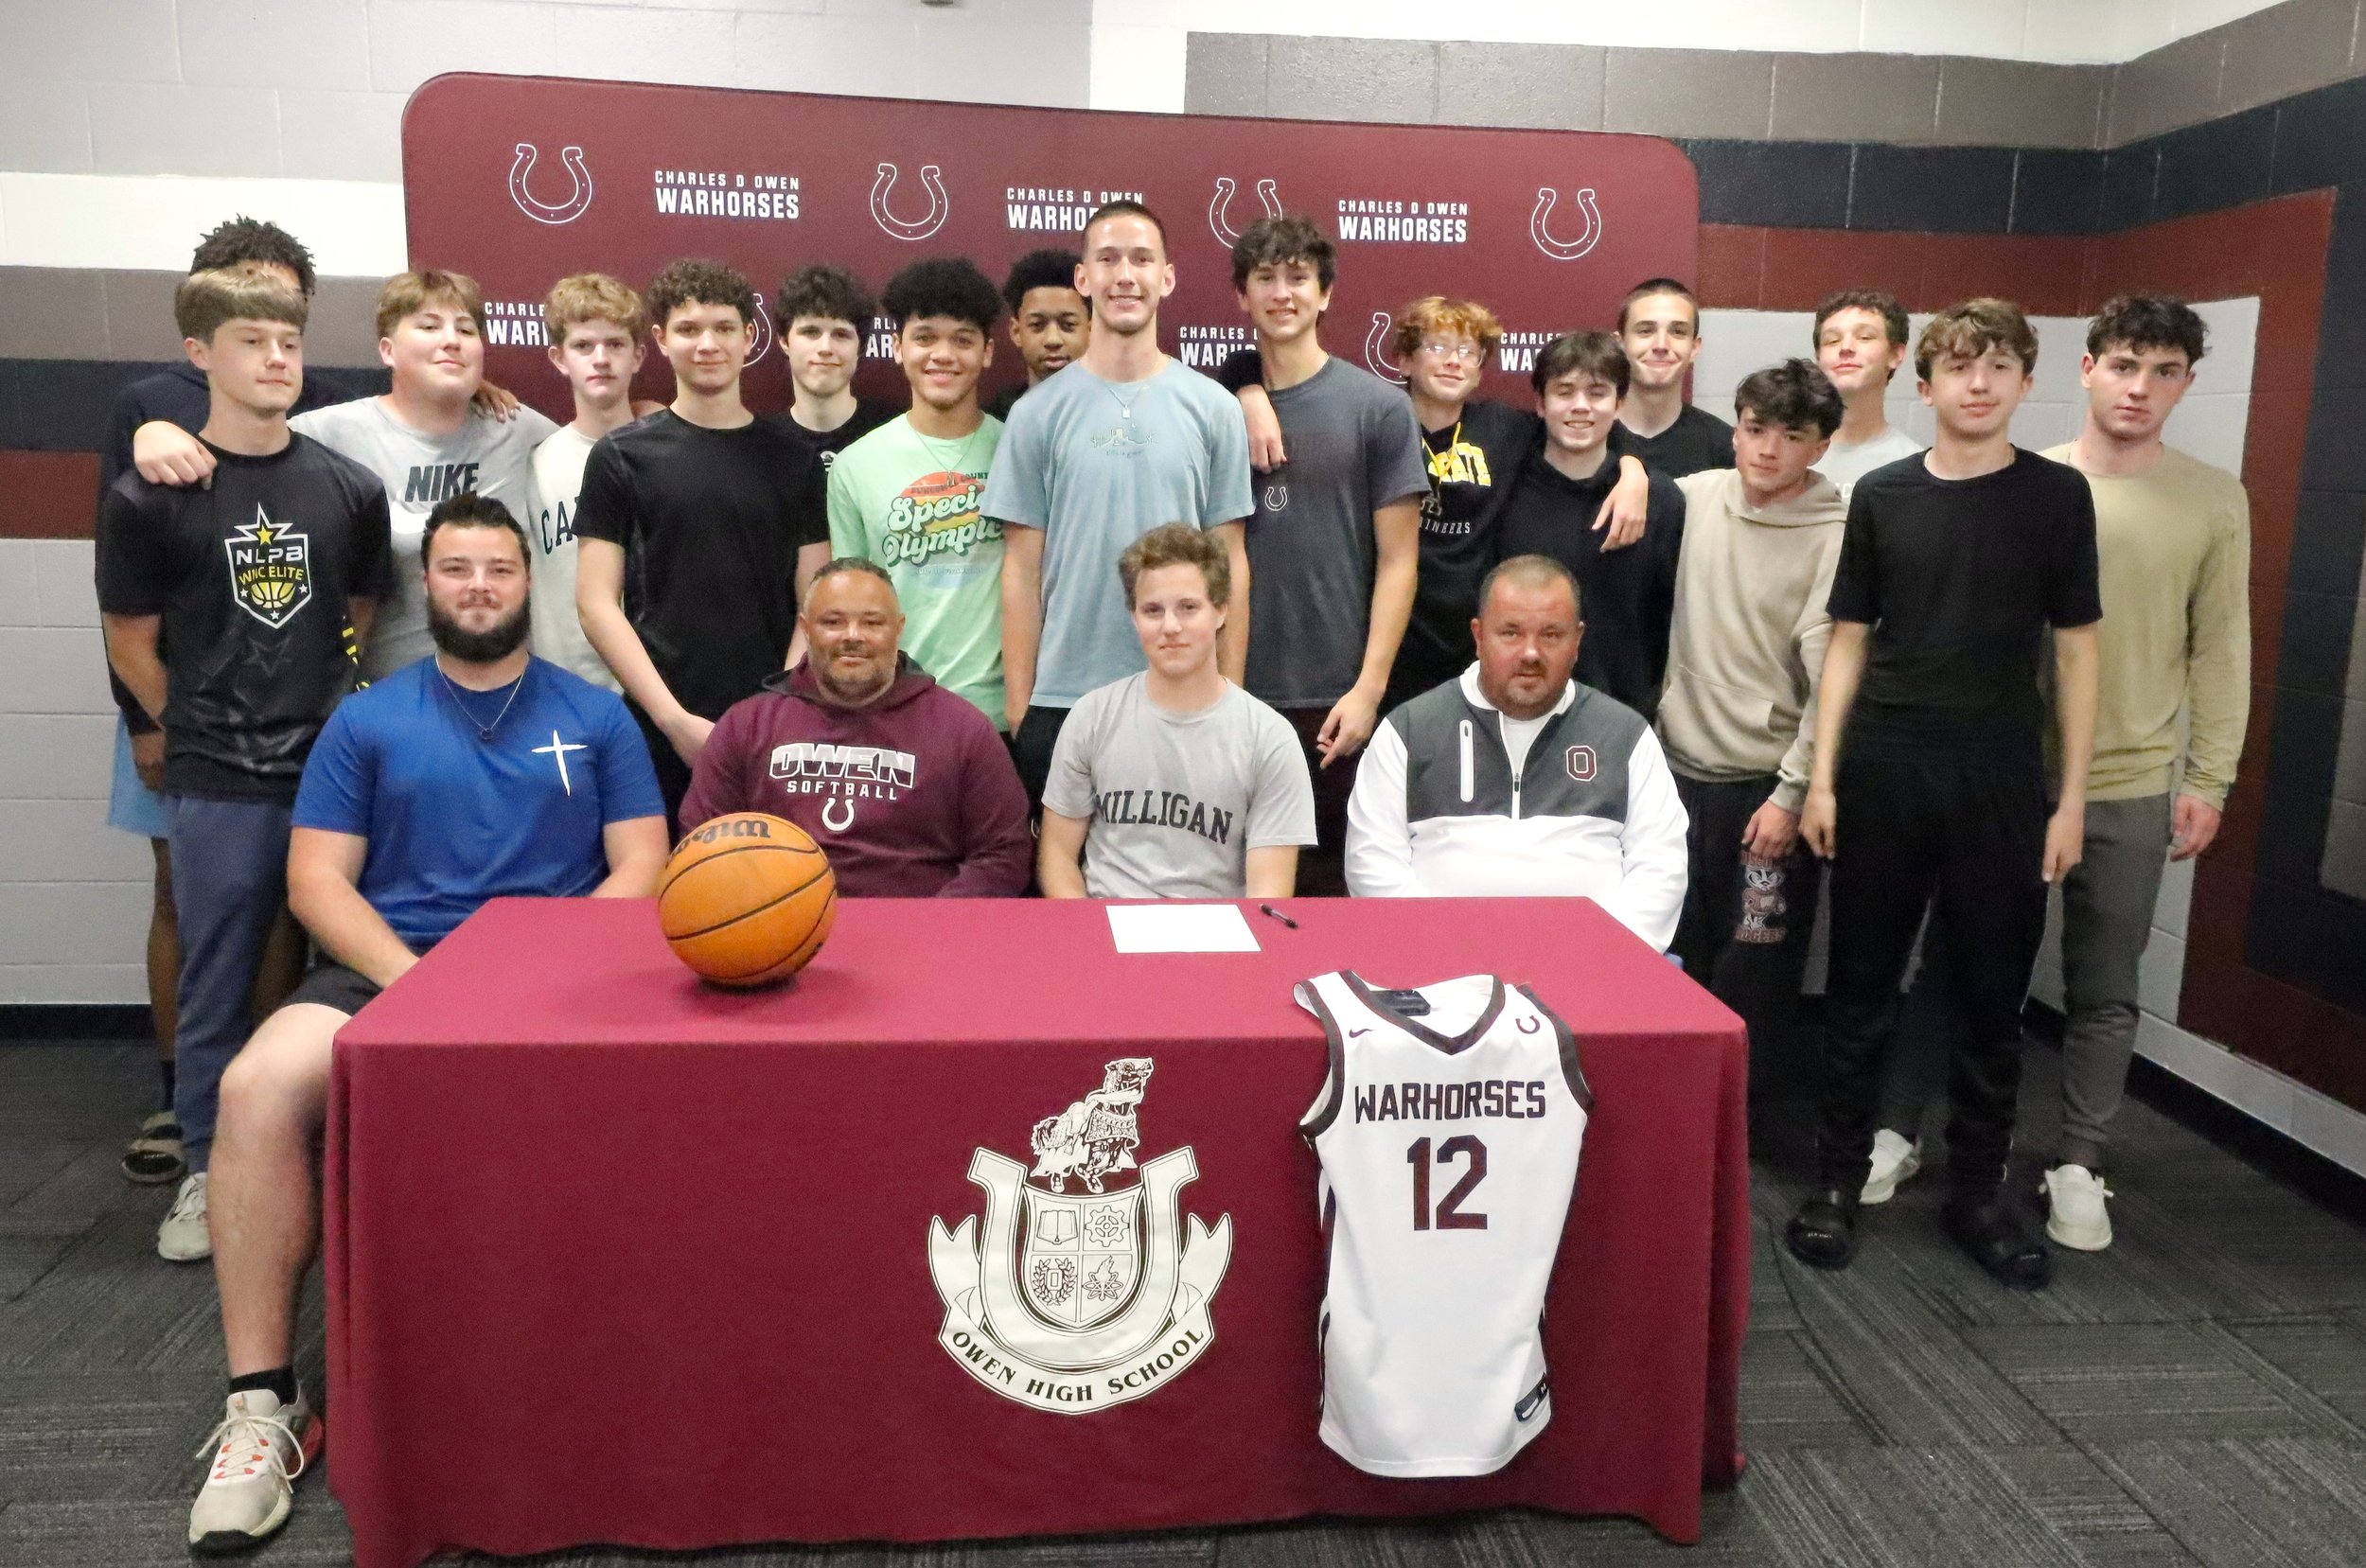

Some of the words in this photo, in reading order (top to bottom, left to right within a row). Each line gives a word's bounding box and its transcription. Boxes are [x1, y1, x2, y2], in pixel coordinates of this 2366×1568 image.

[655, 170, 726, 186] CHARLES
[736, 174, 745, 187] D
[754, 175, 800, 190] OWEN
[1007, 187, 1074, 203] CHARLES
[1084, 190, 1091, 203] D
[655, 187, 800, 220] WARHORSES
[1338, 200, 1403, 214] CHARLES
[1411, 202, 1419, 215] D
[1427, 203, 1468, 216] OWEN
[1338, 216, 1467, 242] WARHORSES
[485, 302, 545, 317] CHARLE
[1179, 326, 1245, 340] CHARLES
[404, 463, 479, 502] NIKE
[888, 484, 980, 532] Speci
[541, 496, 580, 555] CA
[236, 545, 304, 565] NLPB
[268, 566, 304, 581] ELITE
[769, 743, 915, 788] OWEN
[1566, 745, 1597, 782] O
[786, 780, 897, 801] SOFTBALL
[1096, 790, 1233, 844] MILLIGAN
[1354, 1080, 1545, 1124] WARHORSES
[1406, 1135, 1488, 1231] 12
[952, 1330, 1016, 1385] OWEN
[1025, 1378, 1093, 1402] HIGH
[1108, 1330, 1204, 1396] SCHOOL
